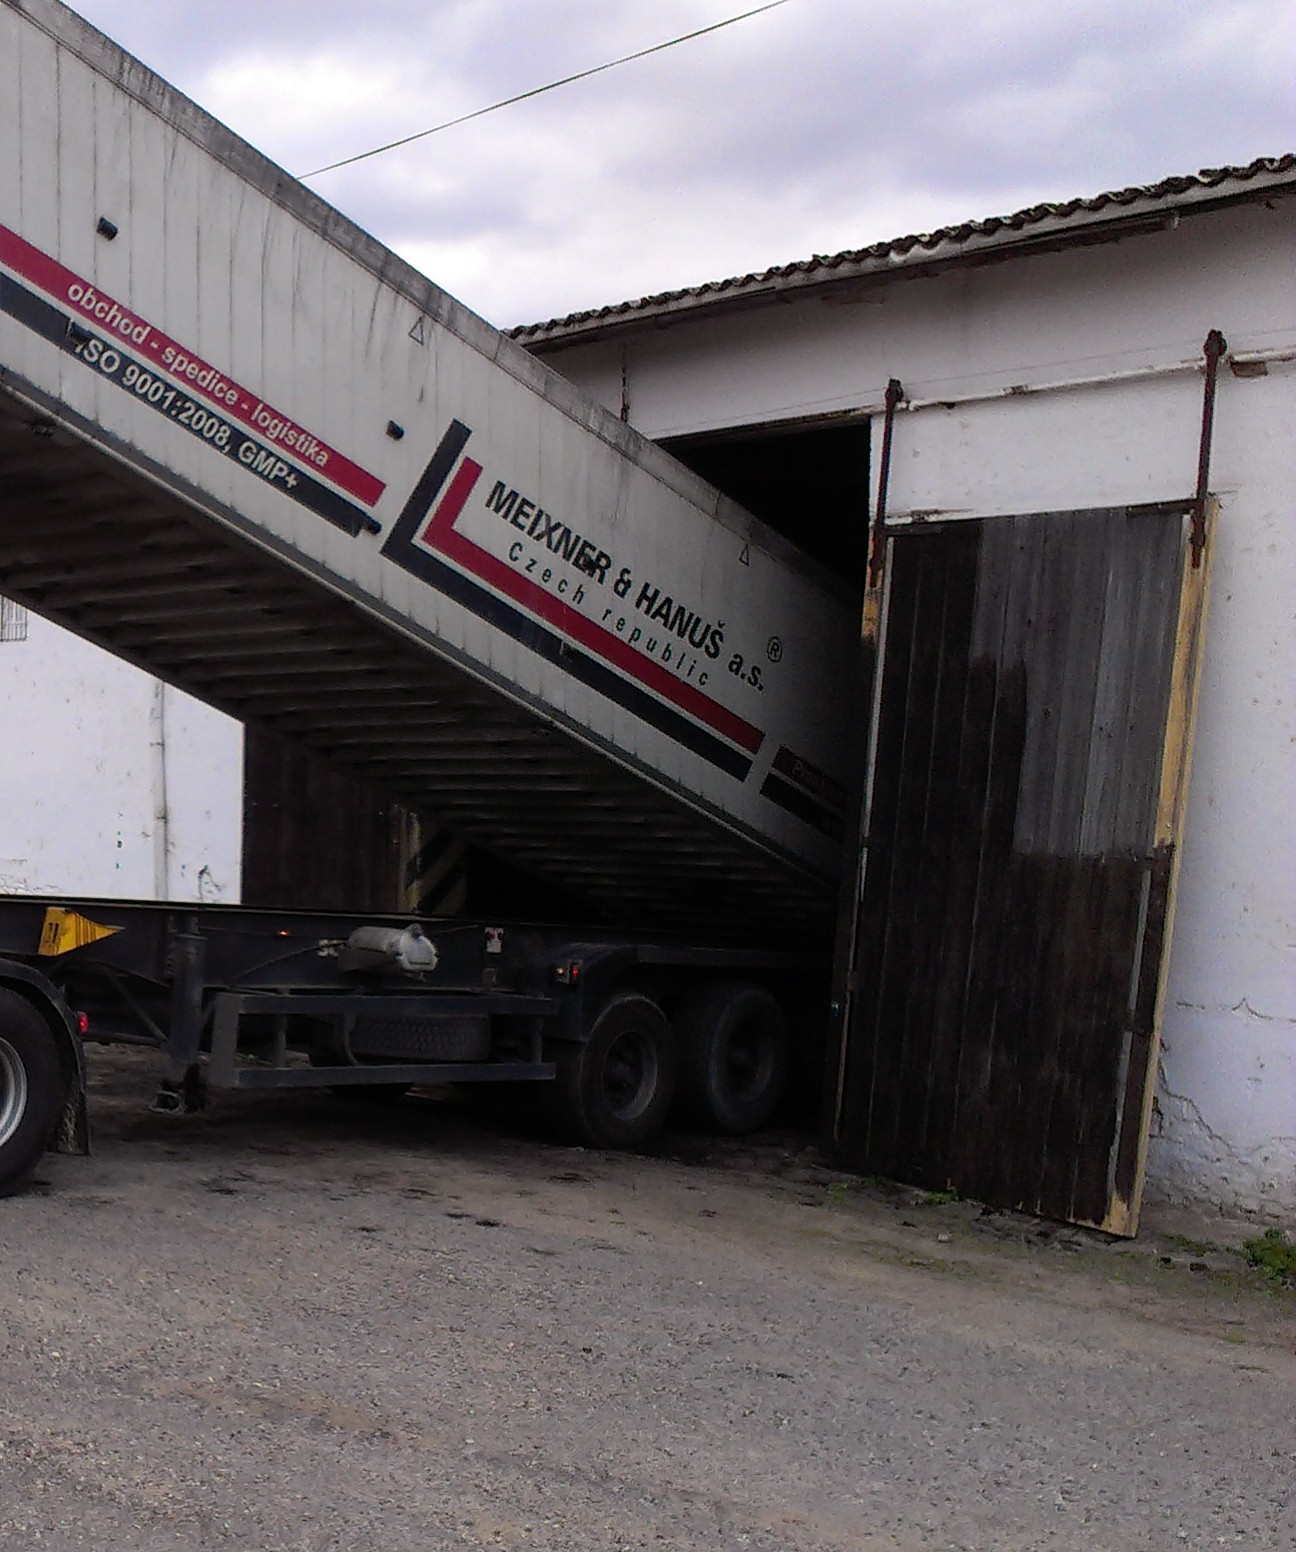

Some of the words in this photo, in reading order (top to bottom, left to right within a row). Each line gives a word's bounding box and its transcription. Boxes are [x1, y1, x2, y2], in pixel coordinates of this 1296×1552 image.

[68, 284, 150, 345] obchod
[162, 346, 239, 406] spedice
[251, 401, 330, 467] logistika
[122, 363, 232, 454] 9001:2008,
[237, 440, 299, 489] GMP+
[485, 480, 612, 585] MEIXNER
[613, 567, 632, 599] &
[635, 582, 726, 659] HANUŠ
[728, 653, 765, 692] a.s.
[508, 542, 585, 604] Czech
[602, 609, 708, 686] republic
